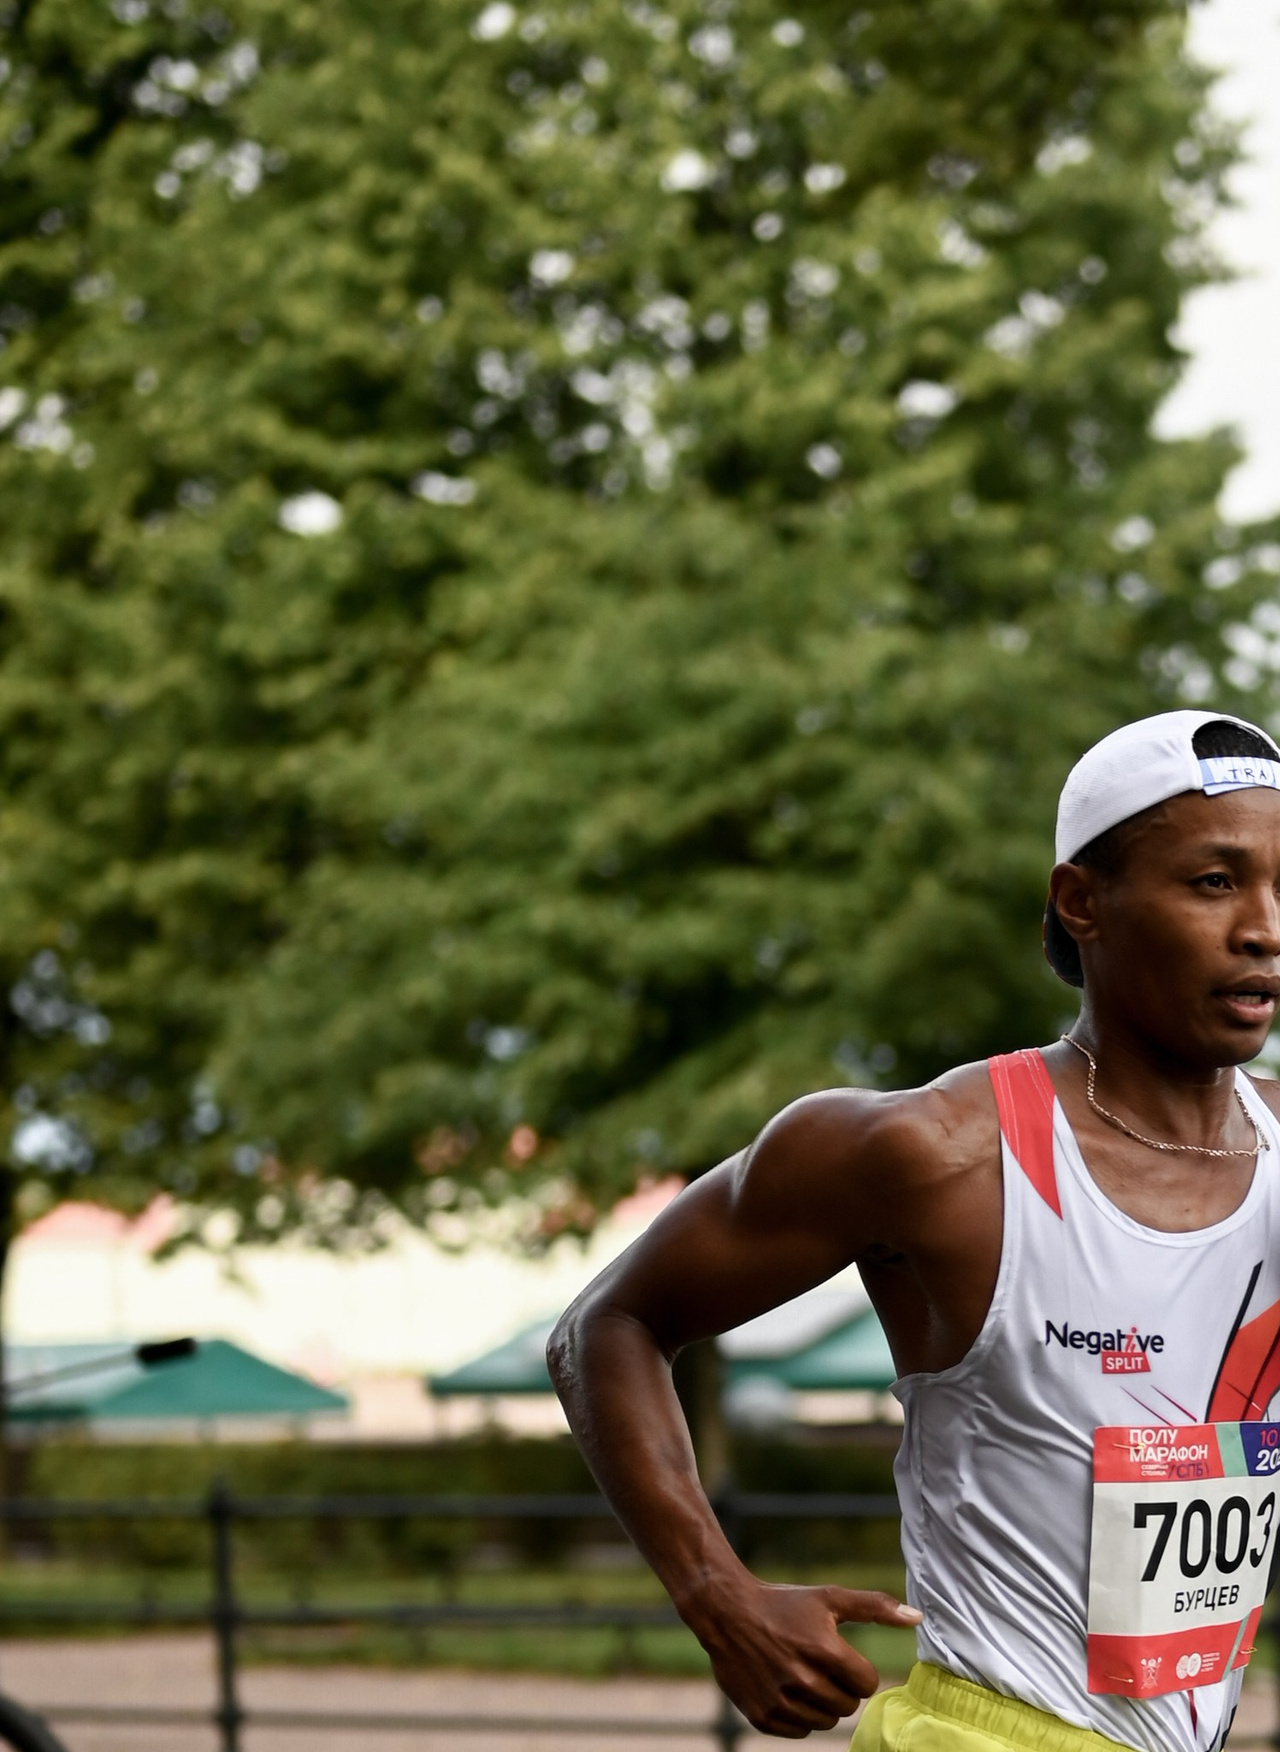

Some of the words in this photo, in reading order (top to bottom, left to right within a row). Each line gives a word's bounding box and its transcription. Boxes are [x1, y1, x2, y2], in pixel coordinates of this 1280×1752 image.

[1045, 1319, 1165, 1355] Negative
[1106, 1356, 1144, 1370] SPLIT
[1129, 1429, 1178, 1445] ПОЛУ
[1261, 1427, 1279, 1447] 10
[1129, 1445, 1208, 1462] МАРАФОН
[1133, 1491, 1275, 1582] 7003
[1173, 1584, 1240, 1613] БУРЦЕВ
